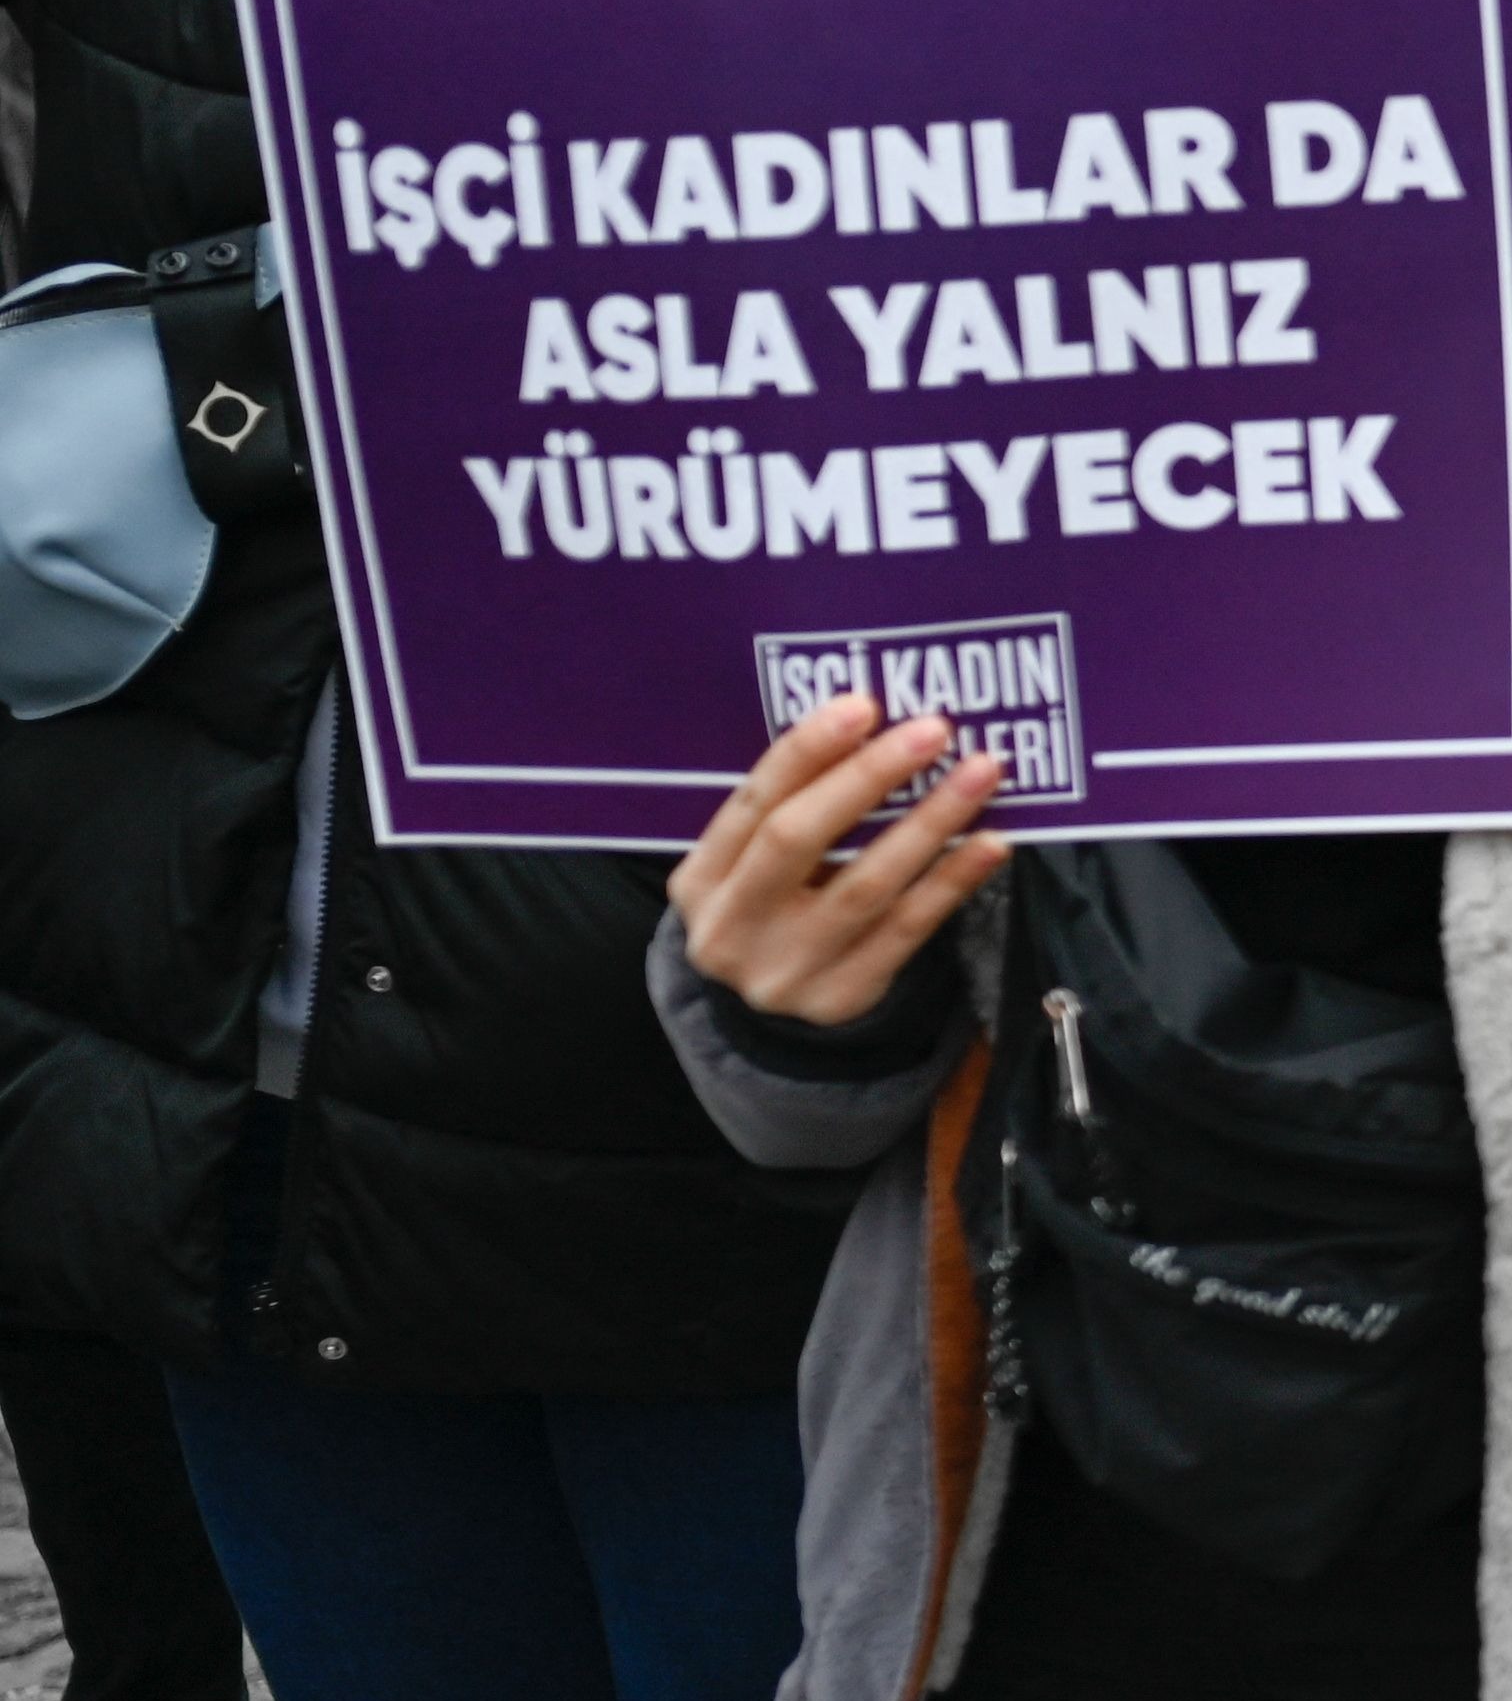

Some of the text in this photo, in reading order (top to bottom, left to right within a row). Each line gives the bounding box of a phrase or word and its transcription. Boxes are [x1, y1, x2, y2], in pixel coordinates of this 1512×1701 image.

[334, 94, 1464, 269] İŞÇİ KADINLAR DA
[520, 257, 1318, 403] ASLA YALNIZ
[463, 413, 1401, 561] YÜRÜMEYECEK
[881, 634, 1063, 722] KADIN
